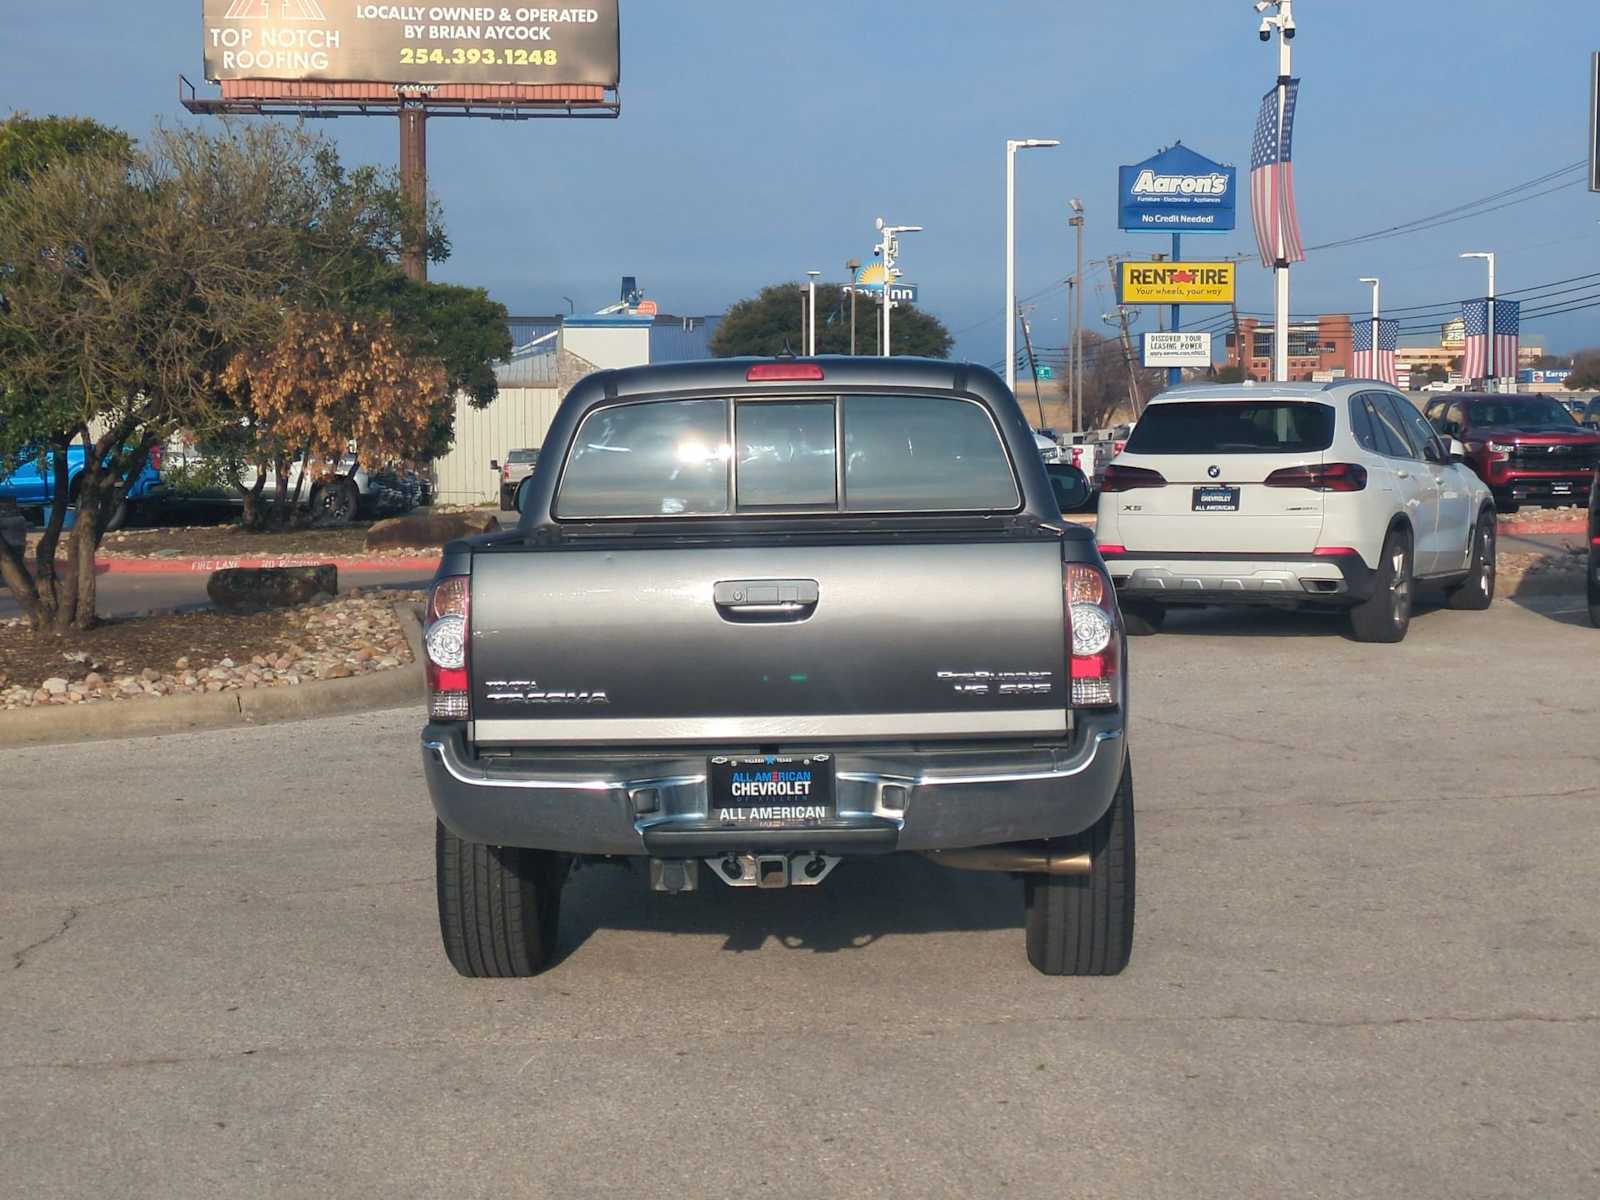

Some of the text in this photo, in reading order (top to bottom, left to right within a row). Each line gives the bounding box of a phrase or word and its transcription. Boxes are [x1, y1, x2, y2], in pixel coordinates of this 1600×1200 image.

[356, 5, 599, 23] LOCALLY OWNED & OPERATED
[210, 28, 340, 49] TOP NOTCH
[404, 25, 551, 40] BY BRIAN AYCOCK
[223, 50, 329, 69] ROOFING
[399, 48, 558, 66] 254.393.1248
[1132, 170, 1228, 195] Aaron's
[1142, 214, 1214, 224] No Credit Needed!
[1130, 268, 1229, 285] RENT TIRE
[1136, 287, 1154, 296] Your
[1187, 289, 1204, 297] your
[1206, 289, 1222, 297] way
[191, 559, 213, 571] FIRE
[732, 770, 812, 783] ALL AMERICAN
[731, 781, 812, 796] CHEVROLET
[719, 806, 826, 821] ALL AMERICAN
